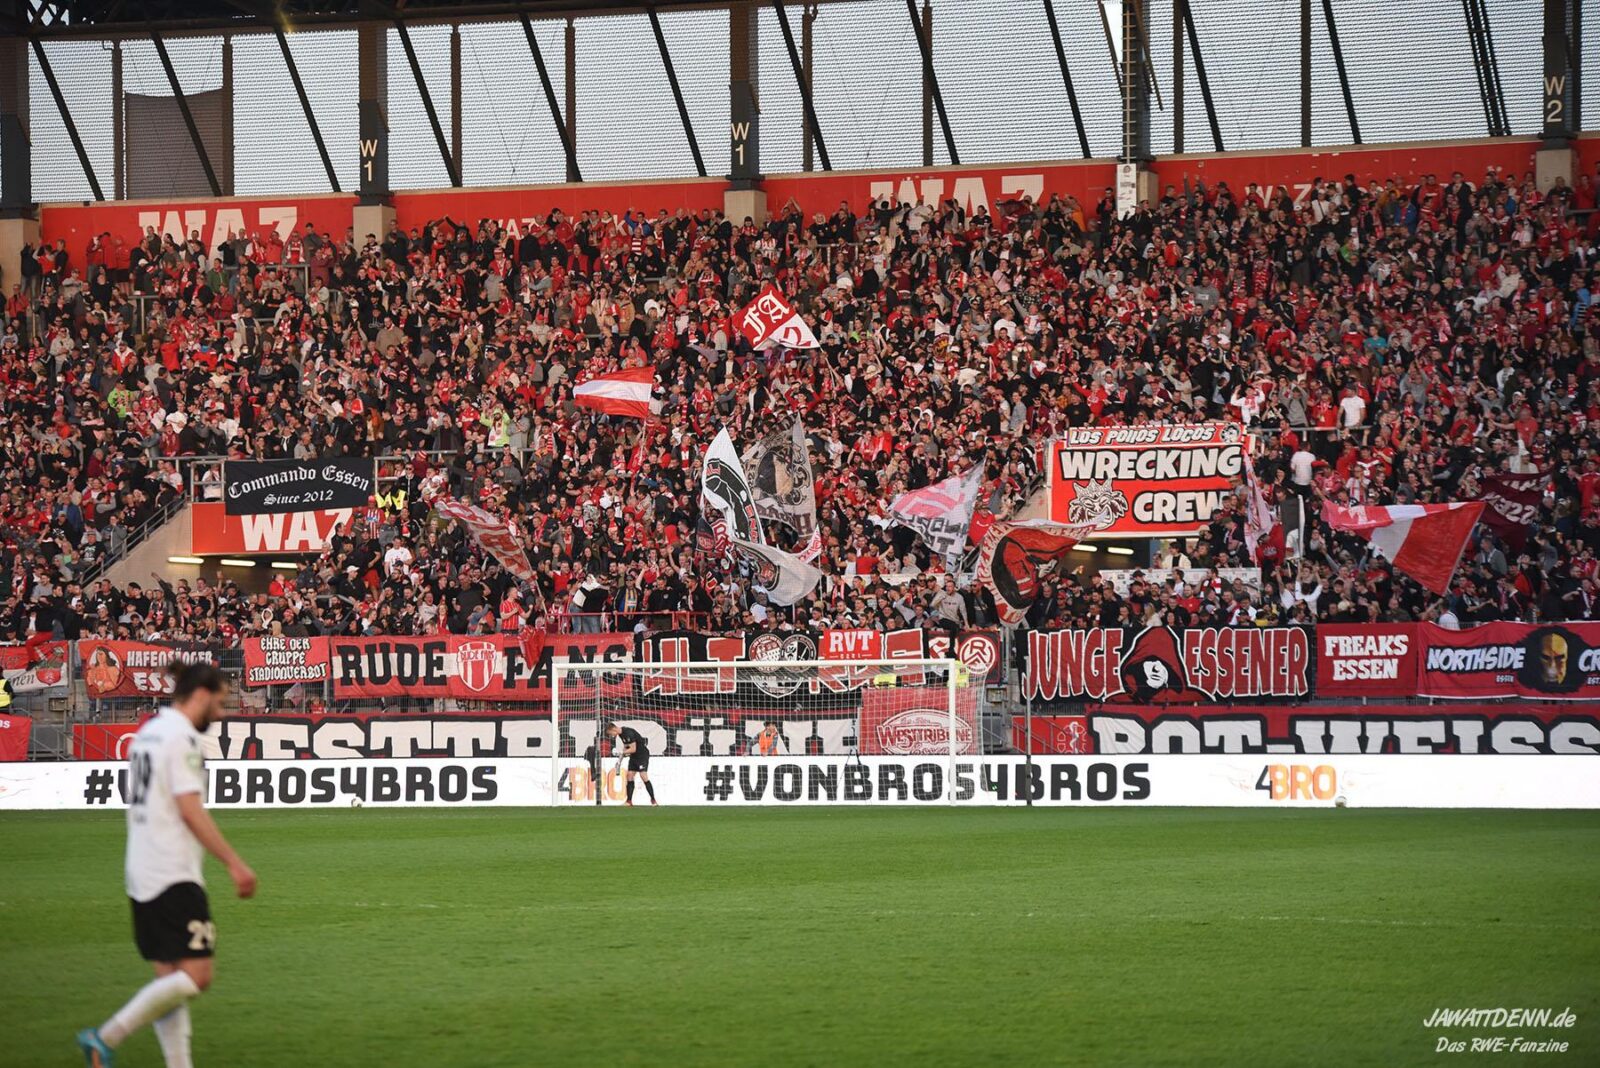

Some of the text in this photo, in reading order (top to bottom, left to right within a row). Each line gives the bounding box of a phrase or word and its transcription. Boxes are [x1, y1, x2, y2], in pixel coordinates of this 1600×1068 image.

[1544, 76, 1565, 96] W
[1547, 100, 1562, 122] 2
[731, 122, 750, 140] W
[360, 139, 377, 157] W
[735, 144, 744, 166] 1
[364, 161, 372, 182] 1
[870, 174, 1043, 232] WAZ
[1245, 183, 1312, 209] WZ
[138, 206, 298, 271] WAZ
[1070, 431, 1102, 445] LOS
[1162, 427, 1215, 442] LOCOS
[1060, 446, 1242, 480] WRECKING
[228, 464, 370, 499] Commando Essen
[263, 489, 334, 506] Since 2012
[1132, 490, 1231, 524] CREW
[240, 508, 353, 552] WAZ
[260, 637, 311, 650] EHRE DER
[829, 630, 874, 653] RVT
[1324, 634, 1409, 656] FREAKS
[336, 641, 627, 690] RUDE FANS
[1021, 627, 1309, 701] JUNGE ESSENER
[1332, 658, 1399, 682] ESSEN
[1426, 646, 1527, 671] NORTHSIDE
[132, 671, 178, 695] ESS
[876, 726, 973, 747] WESTTRIBNE
[84, 765, 499, 804] #BROS4BROS
[703, 762, 1151, 801] #VONBROS4BROS
[1255, 764, 1337, 800] 4BRO
